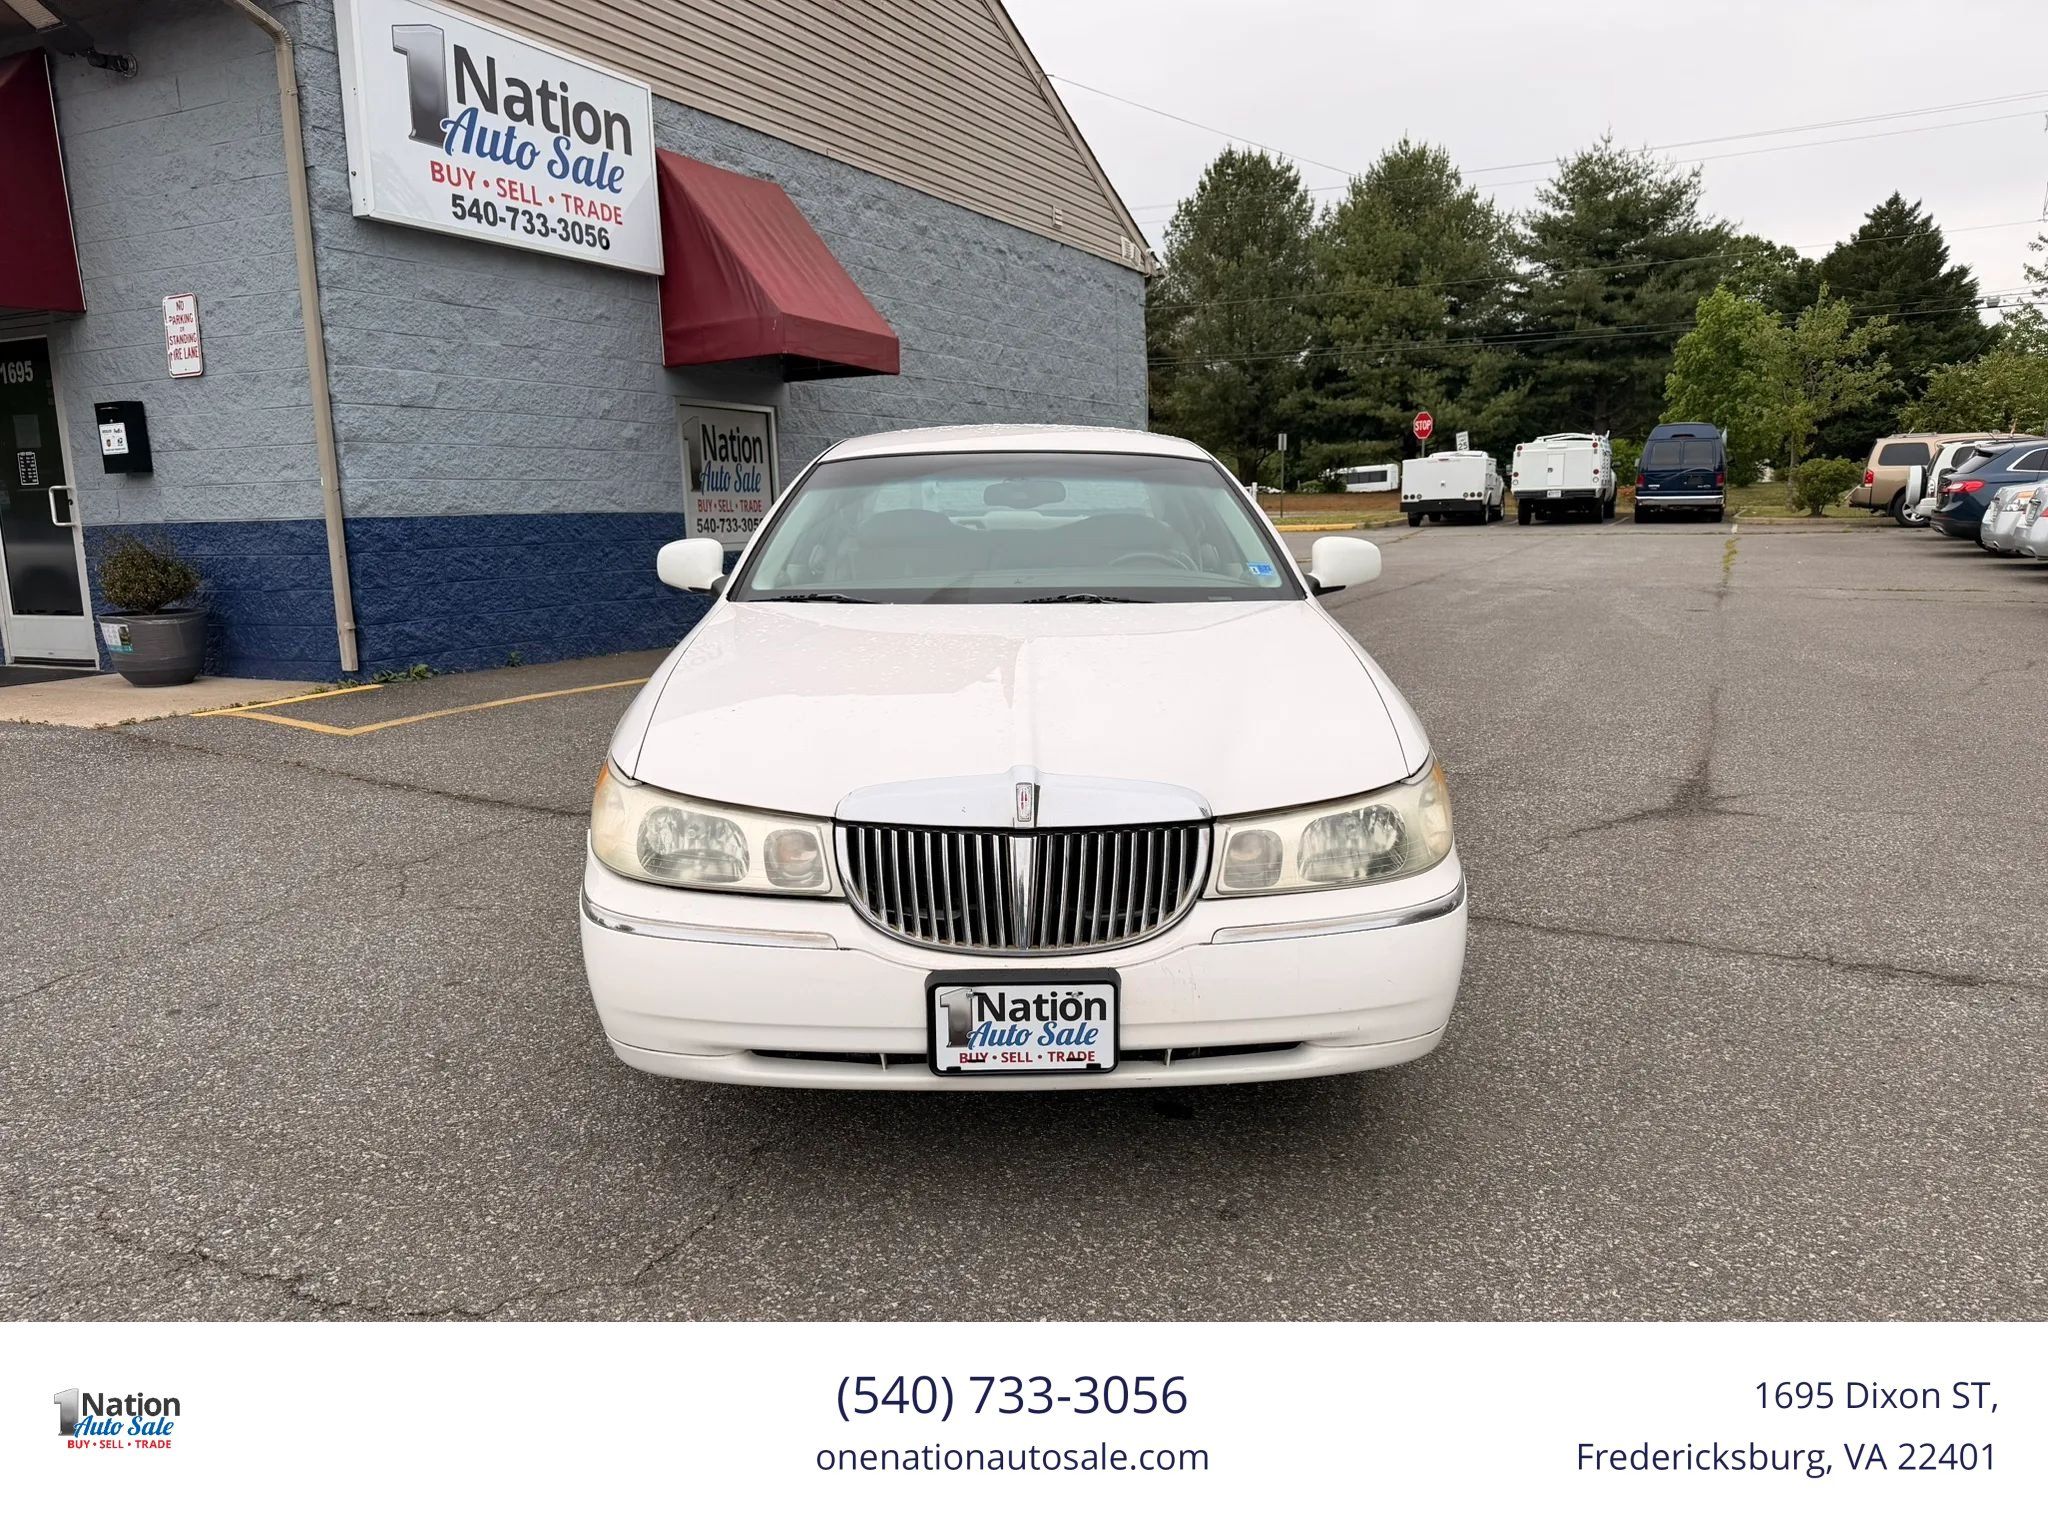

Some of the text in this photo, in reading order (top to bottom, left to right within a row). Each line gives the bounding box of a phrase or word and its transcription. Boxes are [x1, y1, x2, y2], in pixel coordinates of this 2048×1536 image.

[392, 24, 633, 157] 1 Nation
[441, 107, 625, 194] Auto Sale
[430, 160, 623, 226] BUY SELL TRADE
[451, 193, 611, 251] 540-733-3056
[176, 300, 184, 311] NO
[169, 313, 193, 325] PARKING
[169, 333, 197, 346] STANDING
[184, 345, 199, 359] LANE
[0, 360, 34, 384] 1695
[1415, 420, 1432, 431] STOP
[701, 423, 763, 463] Nation
[1458, 442, 1468, 450] 25
[699, 460, 761, 495] Auto Sale
[698, 499, 762, 512] BUY SELL TRADE
[977, 991, 1107, 1023] Nation
[967, 1020, 1099, 1050] Auto Sale
[959, 1050, 1095, 1064] BUY SELL TRADE
